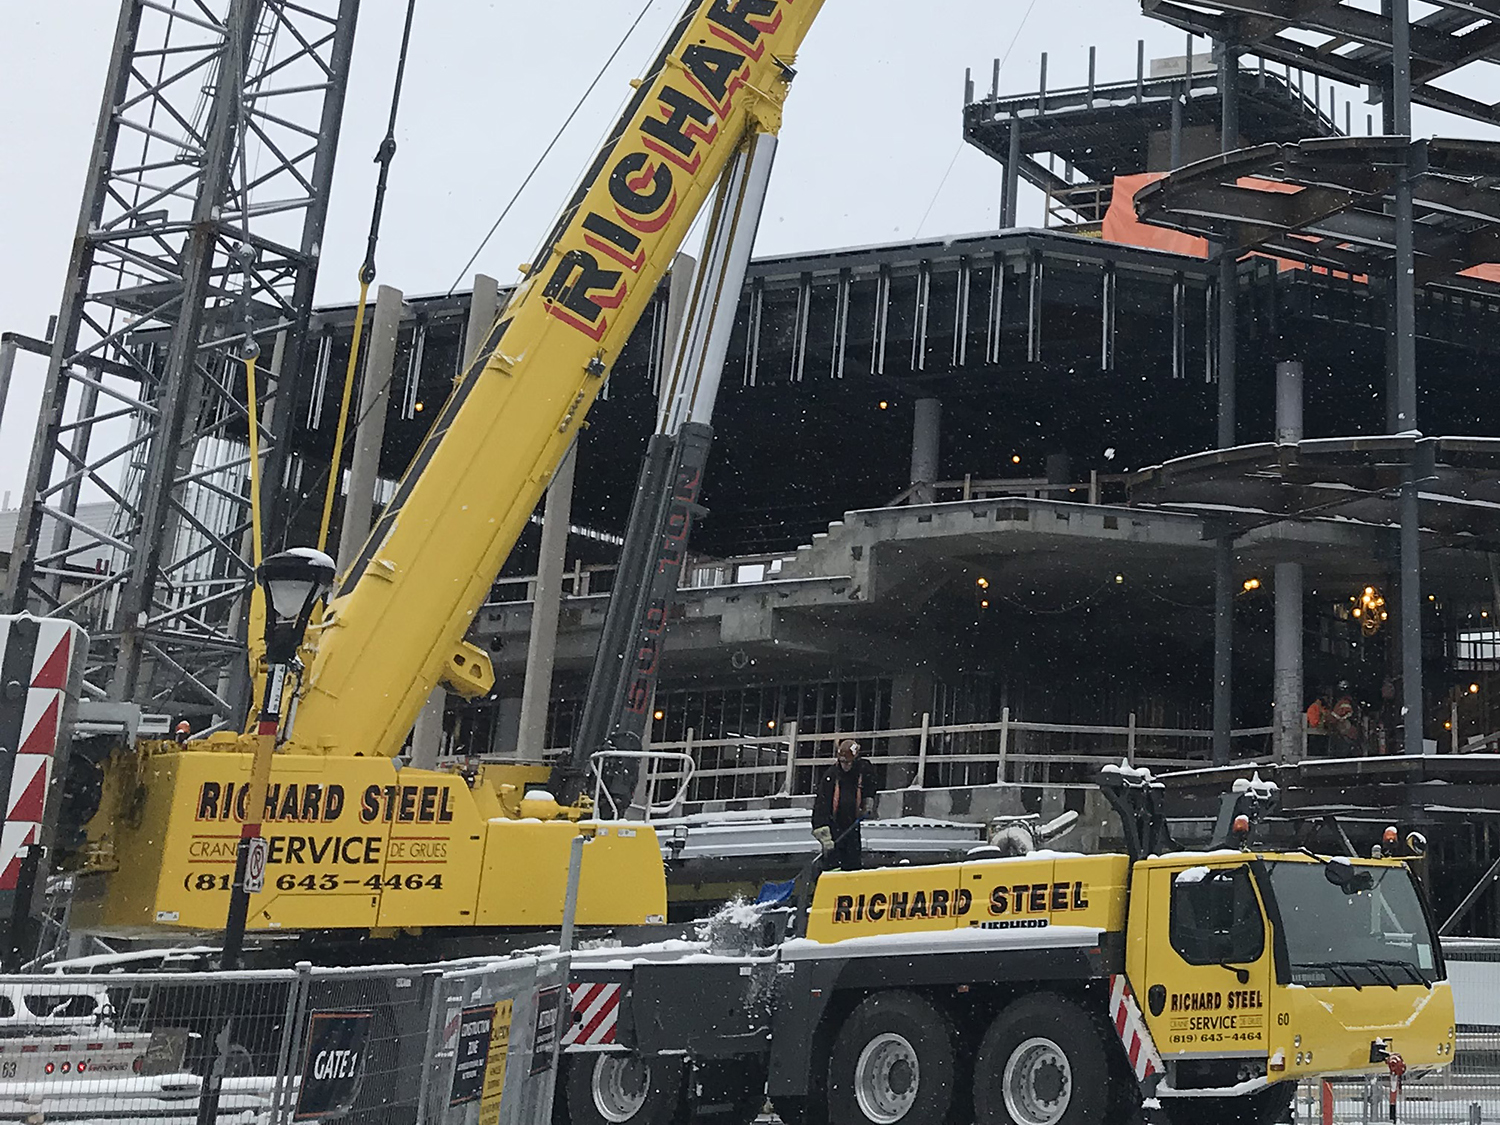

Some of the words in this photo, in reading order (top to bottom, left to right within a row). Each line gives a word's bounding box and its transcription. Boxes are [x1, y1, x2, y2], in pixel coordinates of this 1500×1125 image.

[359, 784, 454, 824] STEEL
[264, 836, 382, 865] ERVICE
[390, 840, 405, 858] DE
[409, 841, 448, 858] GRUES
[276, 872, 444, 892] 643-4464
[832, 888, 972, 925] RICHARD
[988, 881, 1089, 917] STEEL
[1170, 991, 1222, 1012] RICHARD
[1227, 990, 1263, 1010] STEEL
[1189, 1015, 1238, 1031] SERVICE
[1276, 1012, 1290, 1026] 60
[1168, 1033, 1198, 1044] (819)
[314, 1049, 351, 1080] GATE
[347, 1052, 358, 1078] 1
